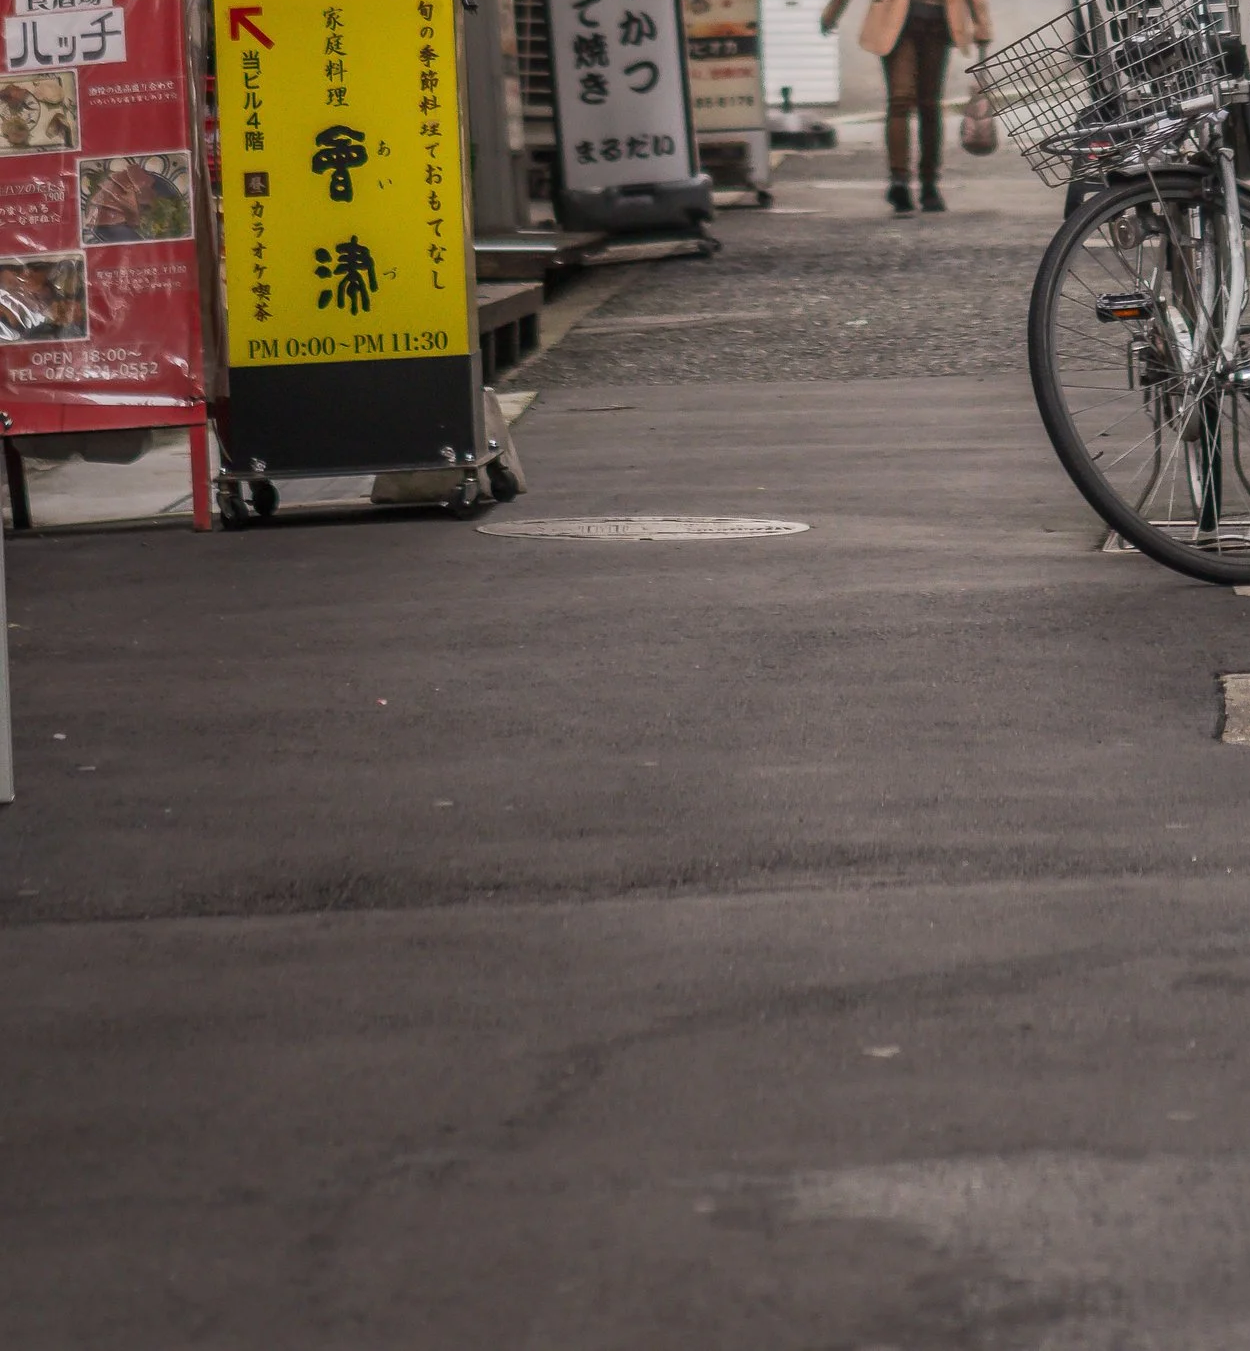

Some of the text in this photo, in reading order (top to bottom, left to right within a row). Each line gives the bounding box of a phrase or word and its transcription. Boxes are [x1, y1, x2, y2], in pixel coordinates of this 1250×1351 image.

[10, 11, 122, 68] ハッチ
[322, 6, 350, 108] 家庭料理
[242, 50, 265, 152] 当ビル4階
[417, 0, 447, 290] 旬の季節料理でおもてなし
[575, 133, 676, 166] まるだい
[251, 201, 273, 323] カラオケ喫茶
[32, 352, 73, 366] OPEN
[248, 338, 279, 359] PM
[392, 330, 449, 352] 11:30
[9, 369, 38, 382] TEL
